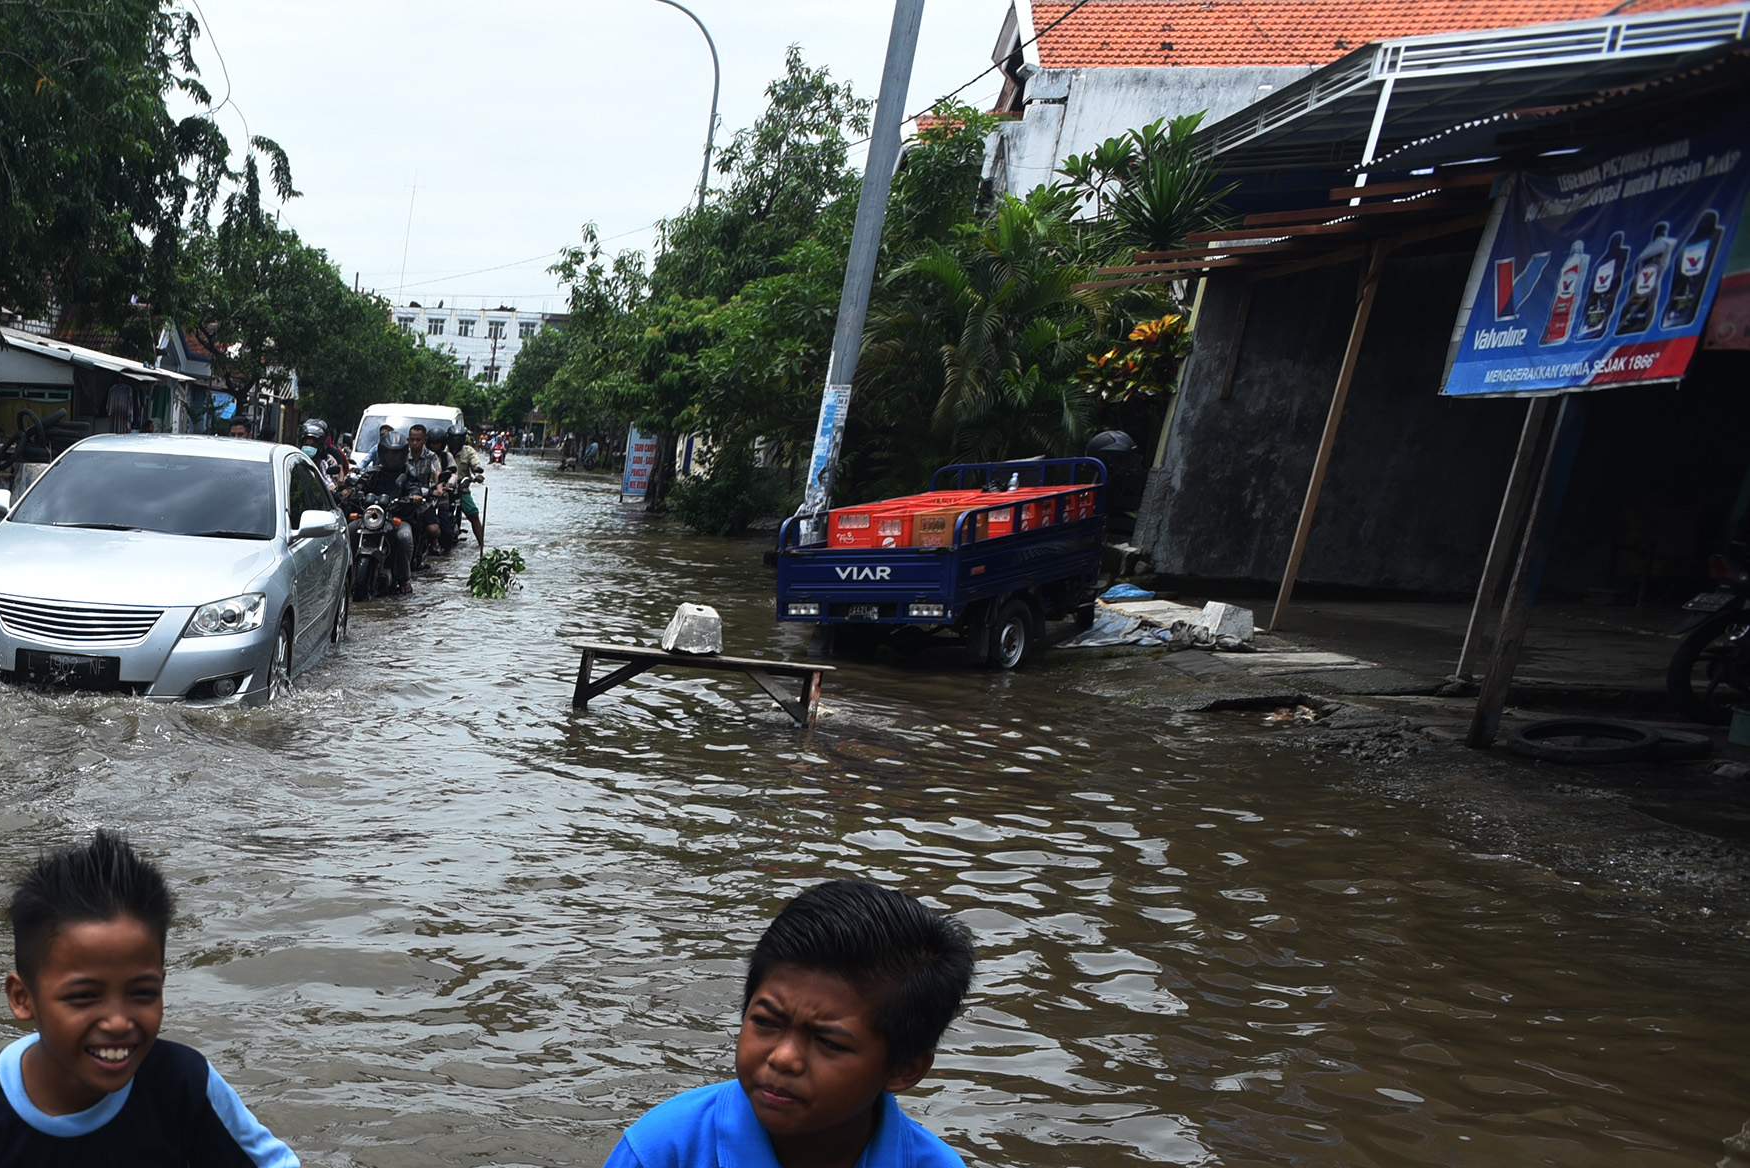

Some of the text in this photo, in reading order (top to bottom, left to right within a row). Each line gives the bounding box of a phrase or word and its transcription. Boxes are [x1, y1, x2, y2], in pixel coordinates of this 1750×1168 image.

[1474, 325, 1528, 350] Valvoline
[1559, 362, 1590, 379] DUNIA
[835, 566, 892, 581] VIAR
[27, 651, 35, 670] L
[89, 658, 107, 676] NF
